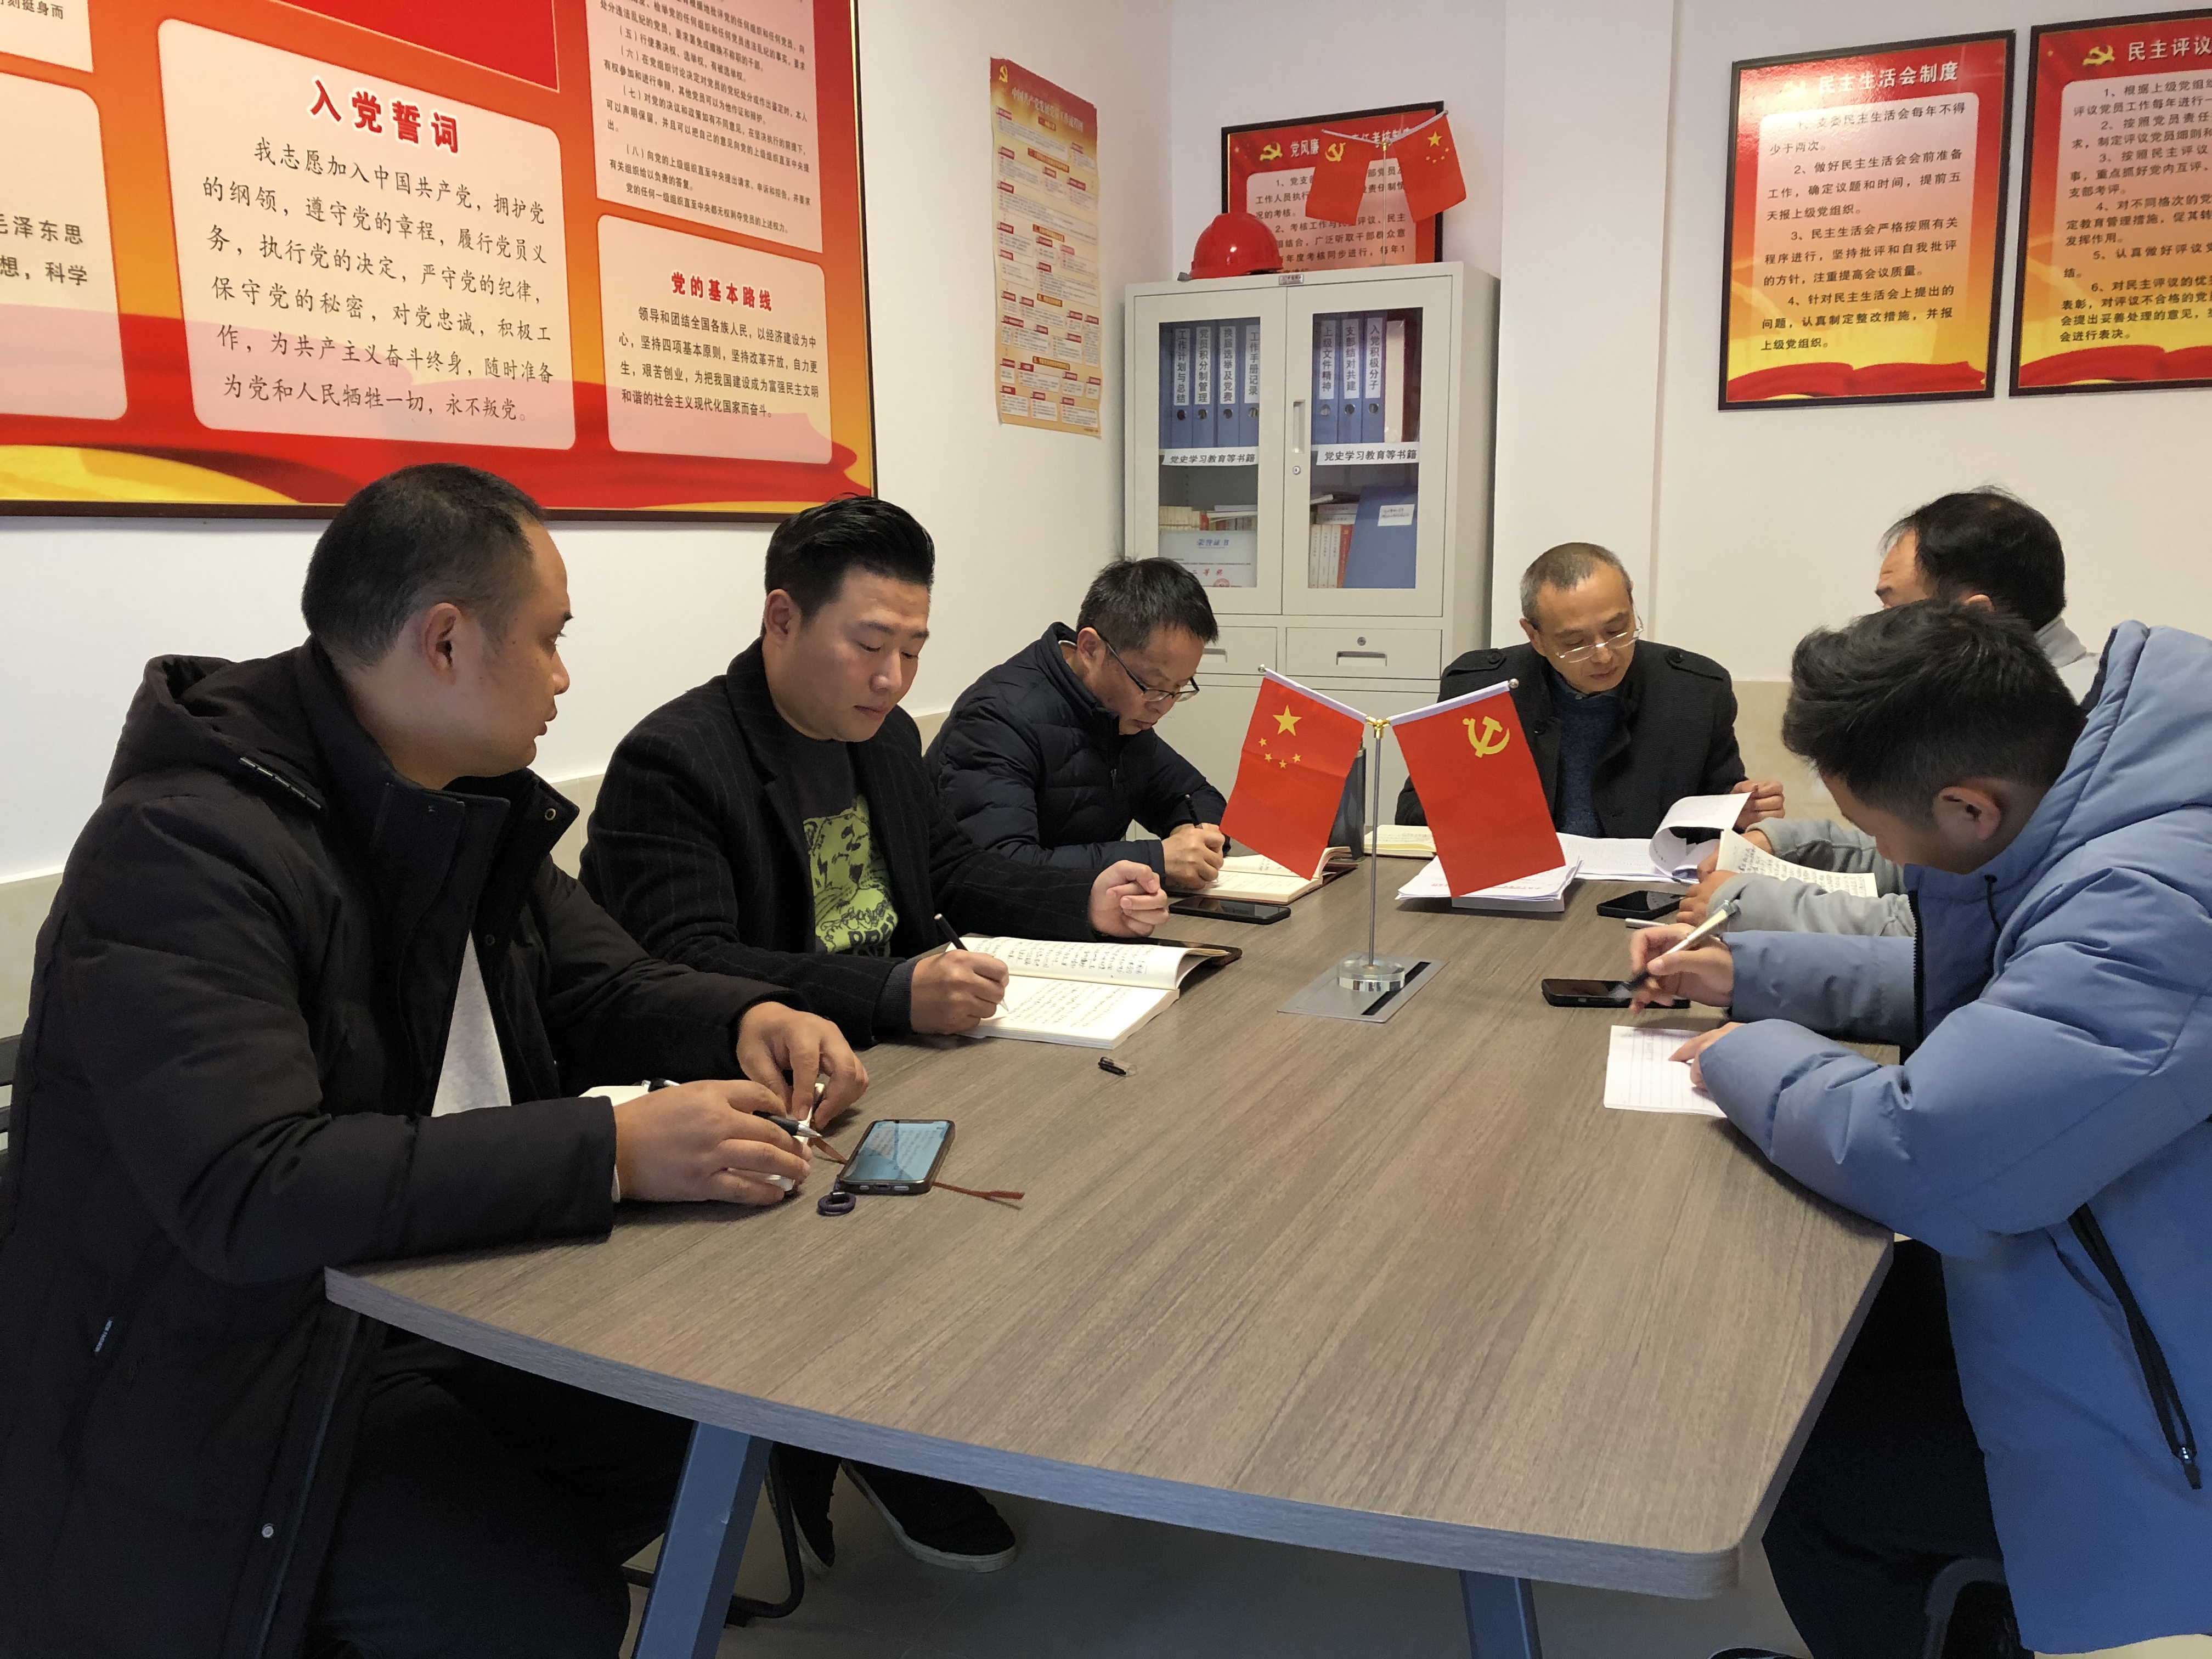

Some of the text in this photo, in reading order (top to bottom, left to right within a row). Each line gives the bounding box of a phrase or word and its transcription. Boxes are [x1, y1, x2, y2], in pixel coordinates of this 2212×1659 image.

[2129, 36, 2212, 61] 民主评议
[1818, 61, 1959, 94] 民主生活会制度
[308, 78, 460, 153] 入党誓词
[607, 119, 619, 132] 出。
[2101, 111, 2212, 131] 2、按照党员责任
[1290, 138, 1319, 157] 党风廉
[1794, 149, 1962, 174] 2、做好民主生活会会前准备
[253, 137, 545, 225] 我志愿加入中国共产党，拥护党
[1768, 172, 1961, 199] 工作，确定议题和时间，提前五
[202, 176, 547, 264] 的纲领，遵守党的章程，履行党员义
[1767, 204, 1860, 221] 天报上级党组织。
[1791, 217, 1958, 241] 3、民主生活会严格按照有关
[206, 224, 541, 304] 务，执行党的决定，严守党的纪律，
[1765, 240, 1957, 264] 程序进行，坚持批评和自我批评
[671, 272, 772, 312] 党的基本路线
[1764, 265, 1922, 286] 的方针，注重提高会议质量。
[2091, 275, 2212, 292] 6、对民主评议的优
[211, 276, 552, 342] 保守党的秘密，对党忠诚，积极工
[1788, 285, 1954, 306] 4、针对民主生活会上提出的
[2062, 291, 2212, 311] 表彰，对评议不合格的党
[638, 306, 817, 349] 领导和团结全国各族人民，以经济建设为中
[1762, 307, 1953, 329] 问题，认真制定整改措施，并报
[217, 324, 553, 385] 作，为共产主义奋斗终身，随时准备
[618, 332, 818, 374] 心，坚持四项基本原则，坚持改革开放，自力更
[1322, 328, 1333, 391] 上级文件精神
[1346, 326, 1356, 391] 支部结对共建
[1369, 325, 1380, 390] 入党积极分子
[1760, 337, 1828, 351] 上级党组织。
[620, 360, 819, 398] 生，艰苦创业，为把我国建设成为富强民主文明
[1177, 330, 1187, 403] 工作计划与总结
[1198, 329, 1208, 402] 党员积分制管理
[1223, 328, 1232, 402] 换届选举及党费
[1249, 332, 1260, 395] 工作手册记录
[223, 375, 526, 421] 为党和人民牺牲一切，永不叛党。
[622, 389, 772, 418] 和谐的社会主义现代化国家而奋斗。
[1170, 453, 1256, 464] 党史学习教育等书籍
[1324, 448, 1417, 461] 党史学习教育等书籍
